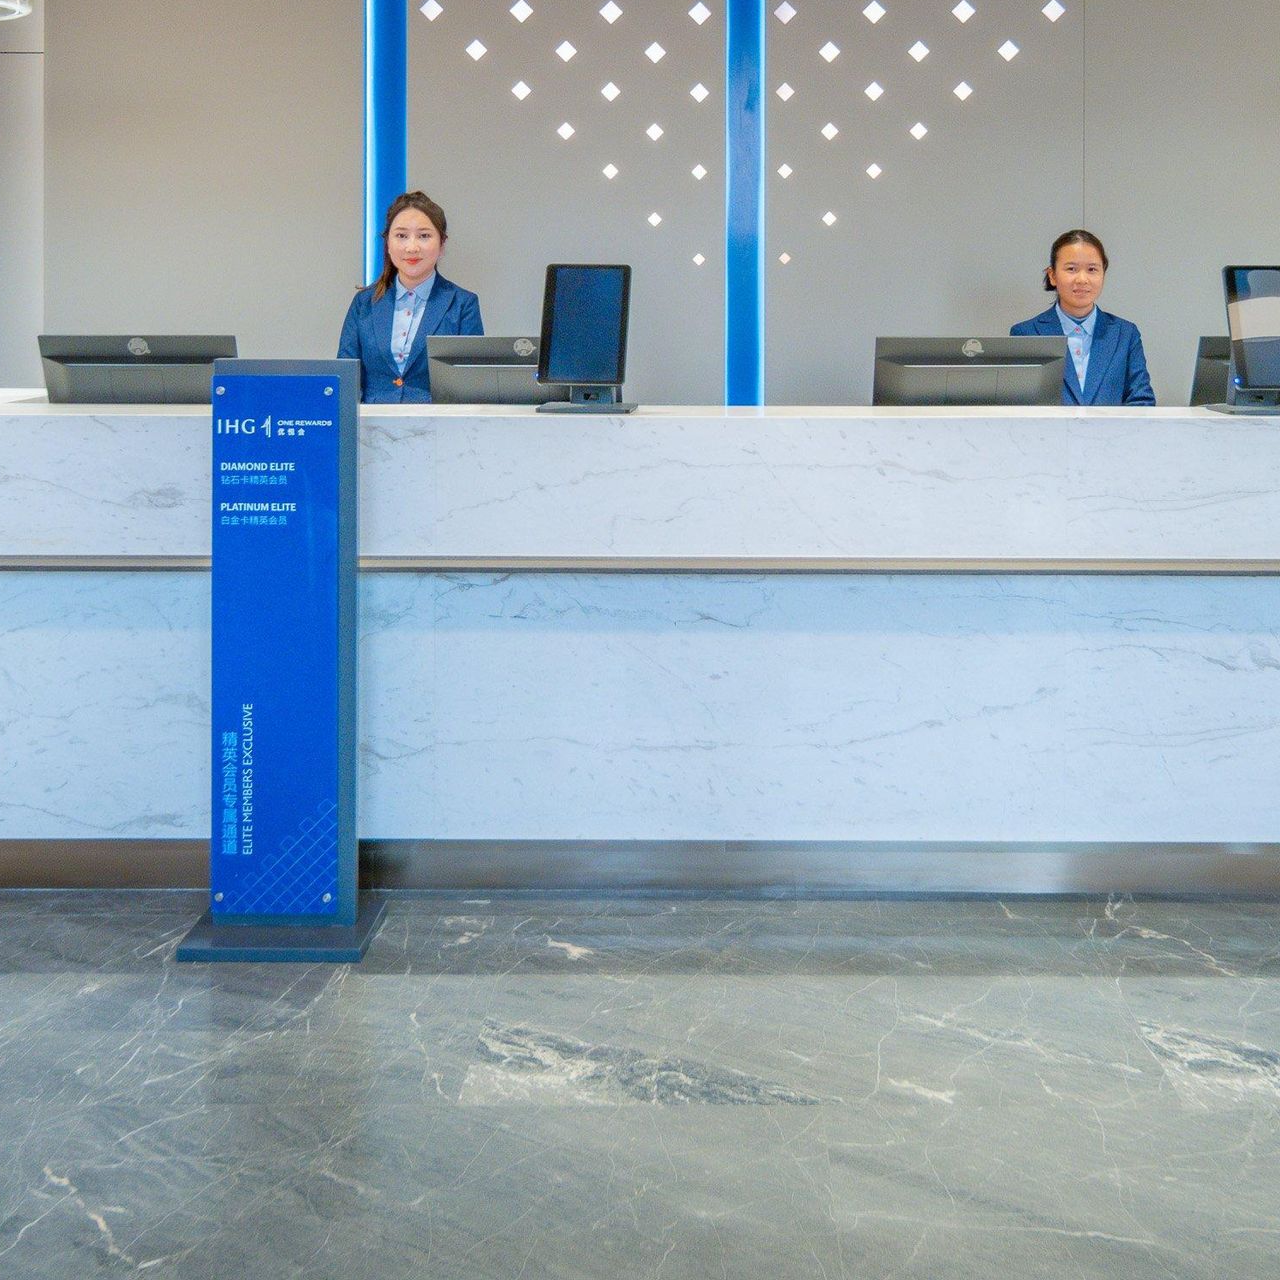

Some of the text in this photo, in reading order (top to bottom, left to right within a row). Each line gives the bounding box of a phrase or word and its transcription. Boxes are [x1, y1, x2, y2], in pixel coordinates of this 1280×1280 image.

[217, 419, 256, 435] IHG
[220, 462, 295, 471] DIAMOND ELITE
[221, 475, 288, 485] 钻石卡精英会员
[220, 502, 296, 512] PLATINUM ELITE
[221, 515, 288, 526] 白金卡精英会员
[242, 703, 253, 855] ELITE MEMBERS EXCLUSIVE
[222, 731, 238, 855] 精英会员专属通道
